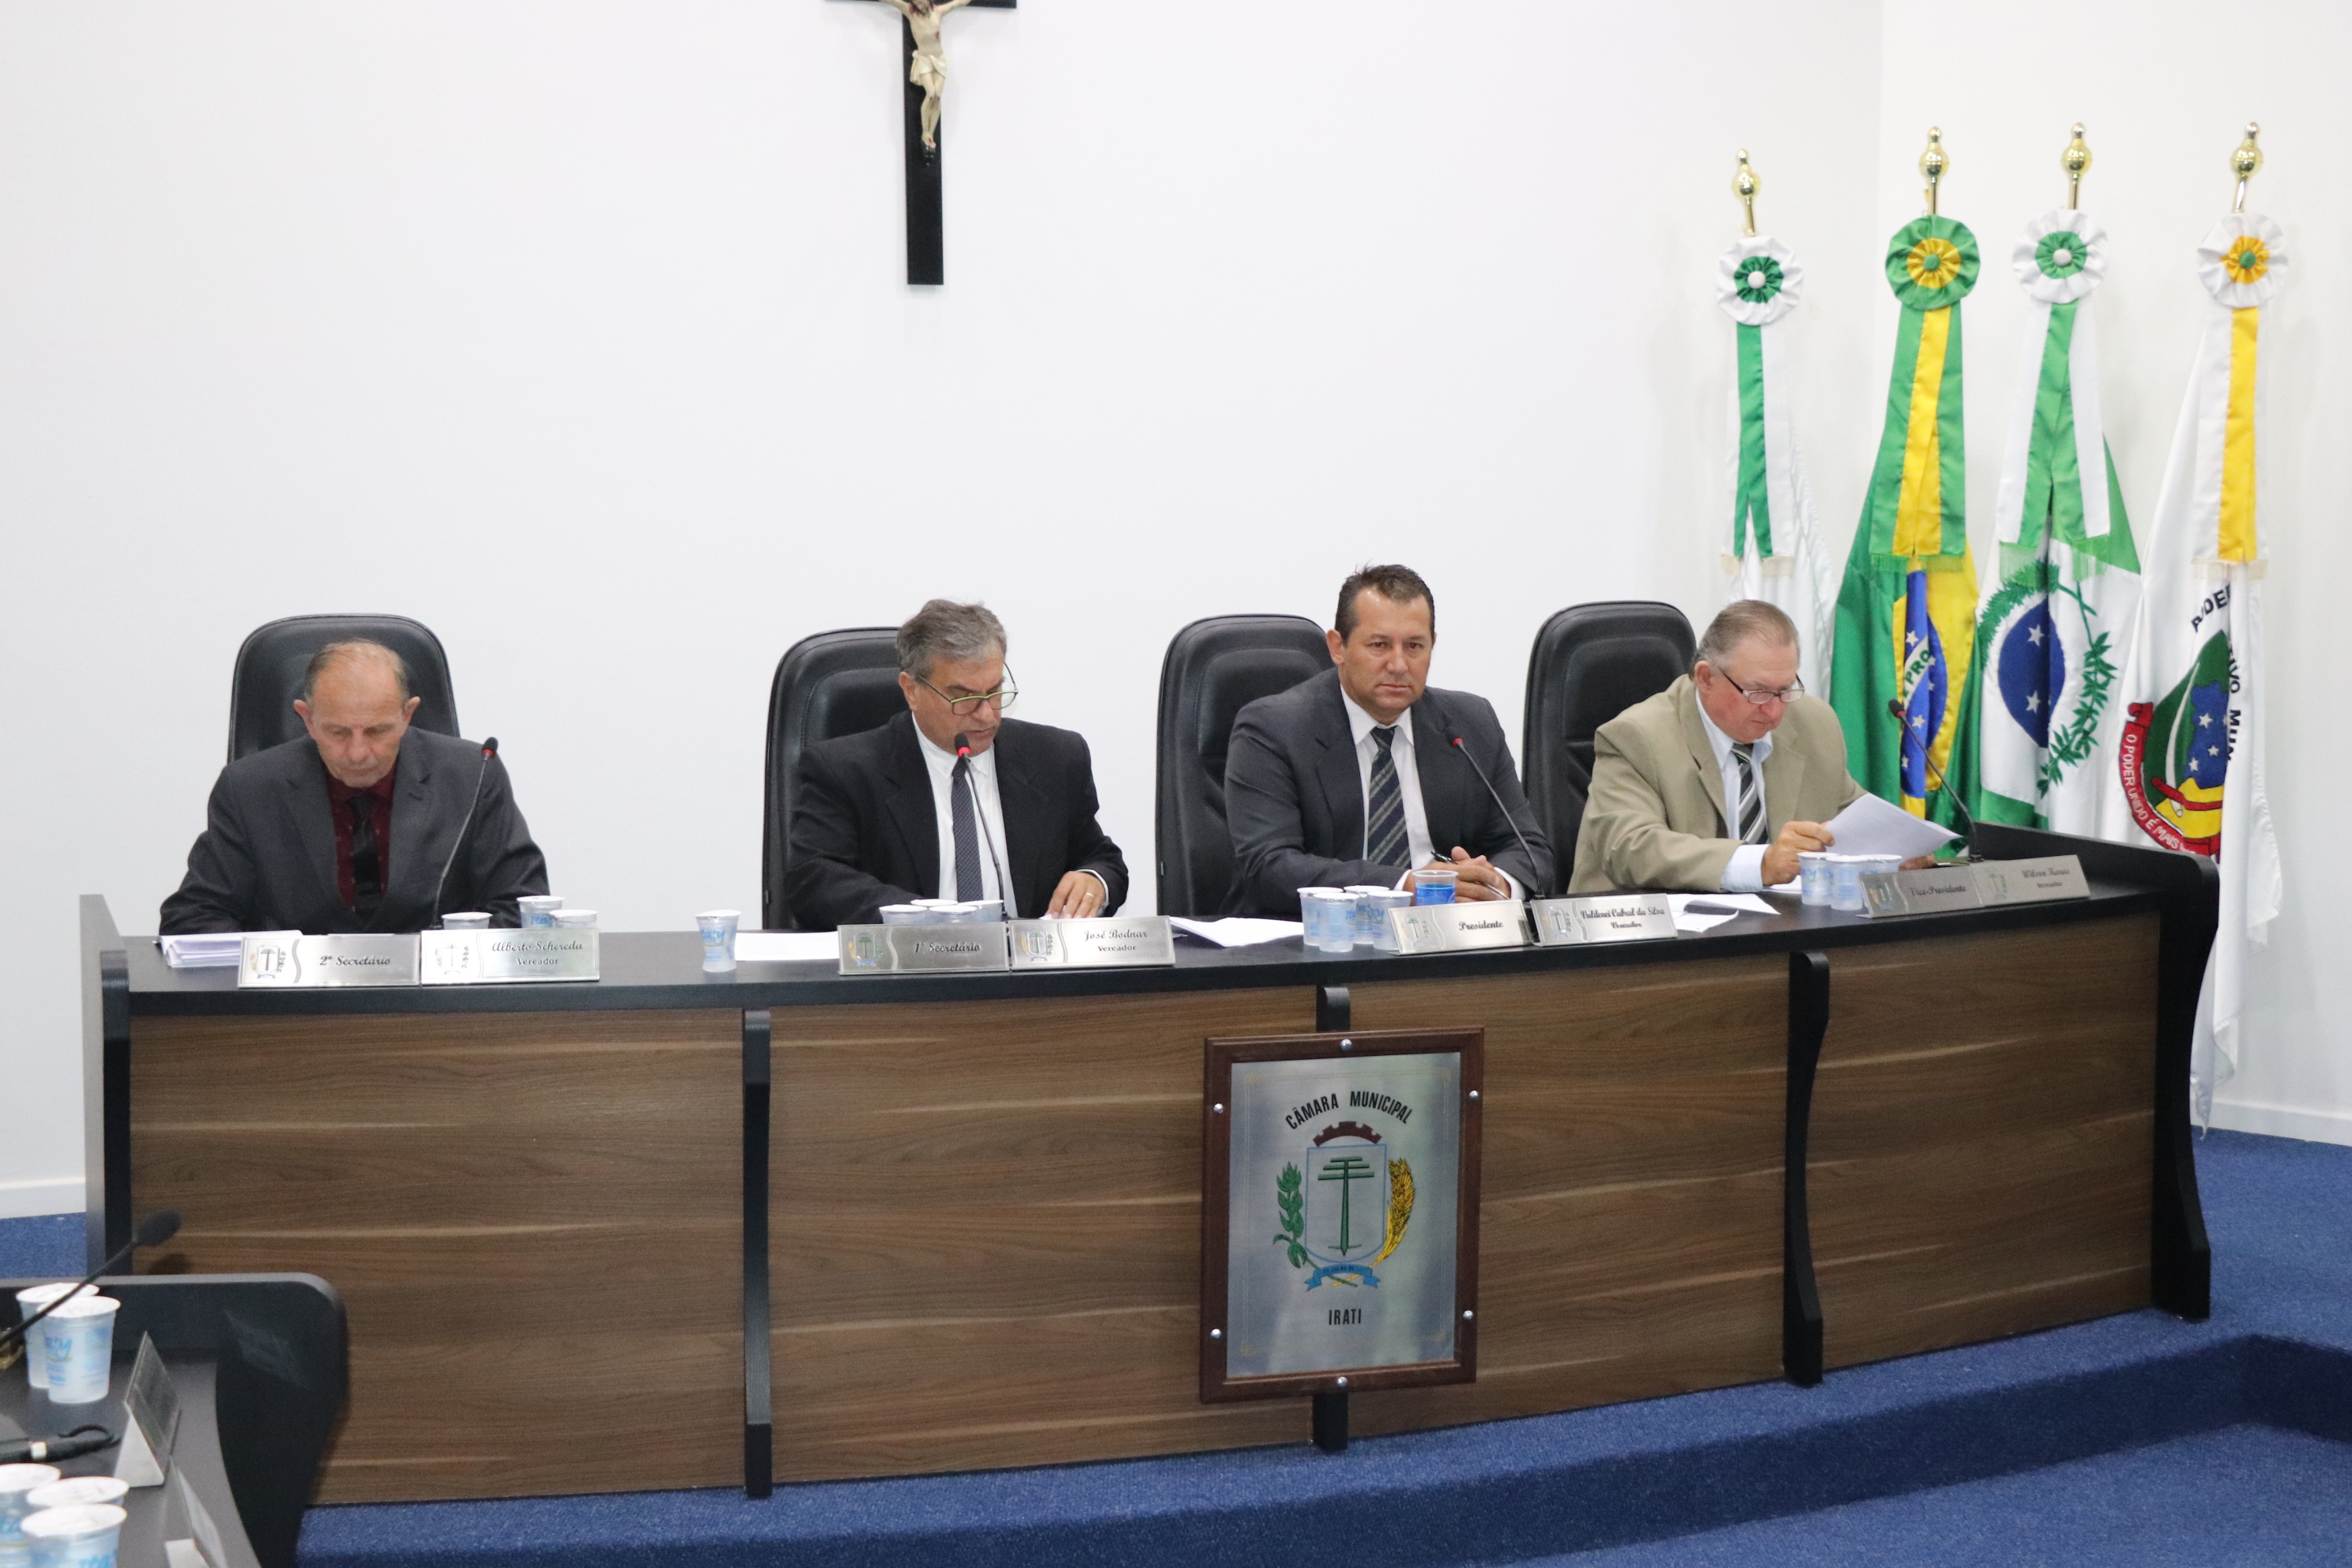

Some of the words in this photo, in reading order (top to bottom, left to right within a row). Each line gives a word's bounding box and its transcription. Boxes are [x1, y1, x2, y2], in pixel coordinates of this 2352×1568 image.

[2191, 584, 2230, 632] PDE
[2125, 734, 2137, 743] O
[2122, 745, 2135, 786] PODER
[2128, 788, 2149, 820] UNIDO
[2145, 819, 2158, 830] É
[2152, 825, 2179, 850] MAIS
[1909, 884, 1966, 896] Vice-Presidente
[1611, 907, 1634, 917] Cabral
[1648, 906, 1664, 915] Silva
[1458, 920, 1504, 931] Presidente
[1084, 930, 1106, 941] José
[1109, 929, 1148, 939] Bodnar
[492, 941, 531, 952] Alberto
[534, 940, 582, 950] Schereda
[928, 941, 981, 952] Secretário
[335, 955, 391, 966] Secretário
[1285, 1093, 1339, 1129] CÂMARA
[1350, 1091, 1413, 1124] MUNICIPAL
[1329, 1308, 1362, 1325] IRATI
